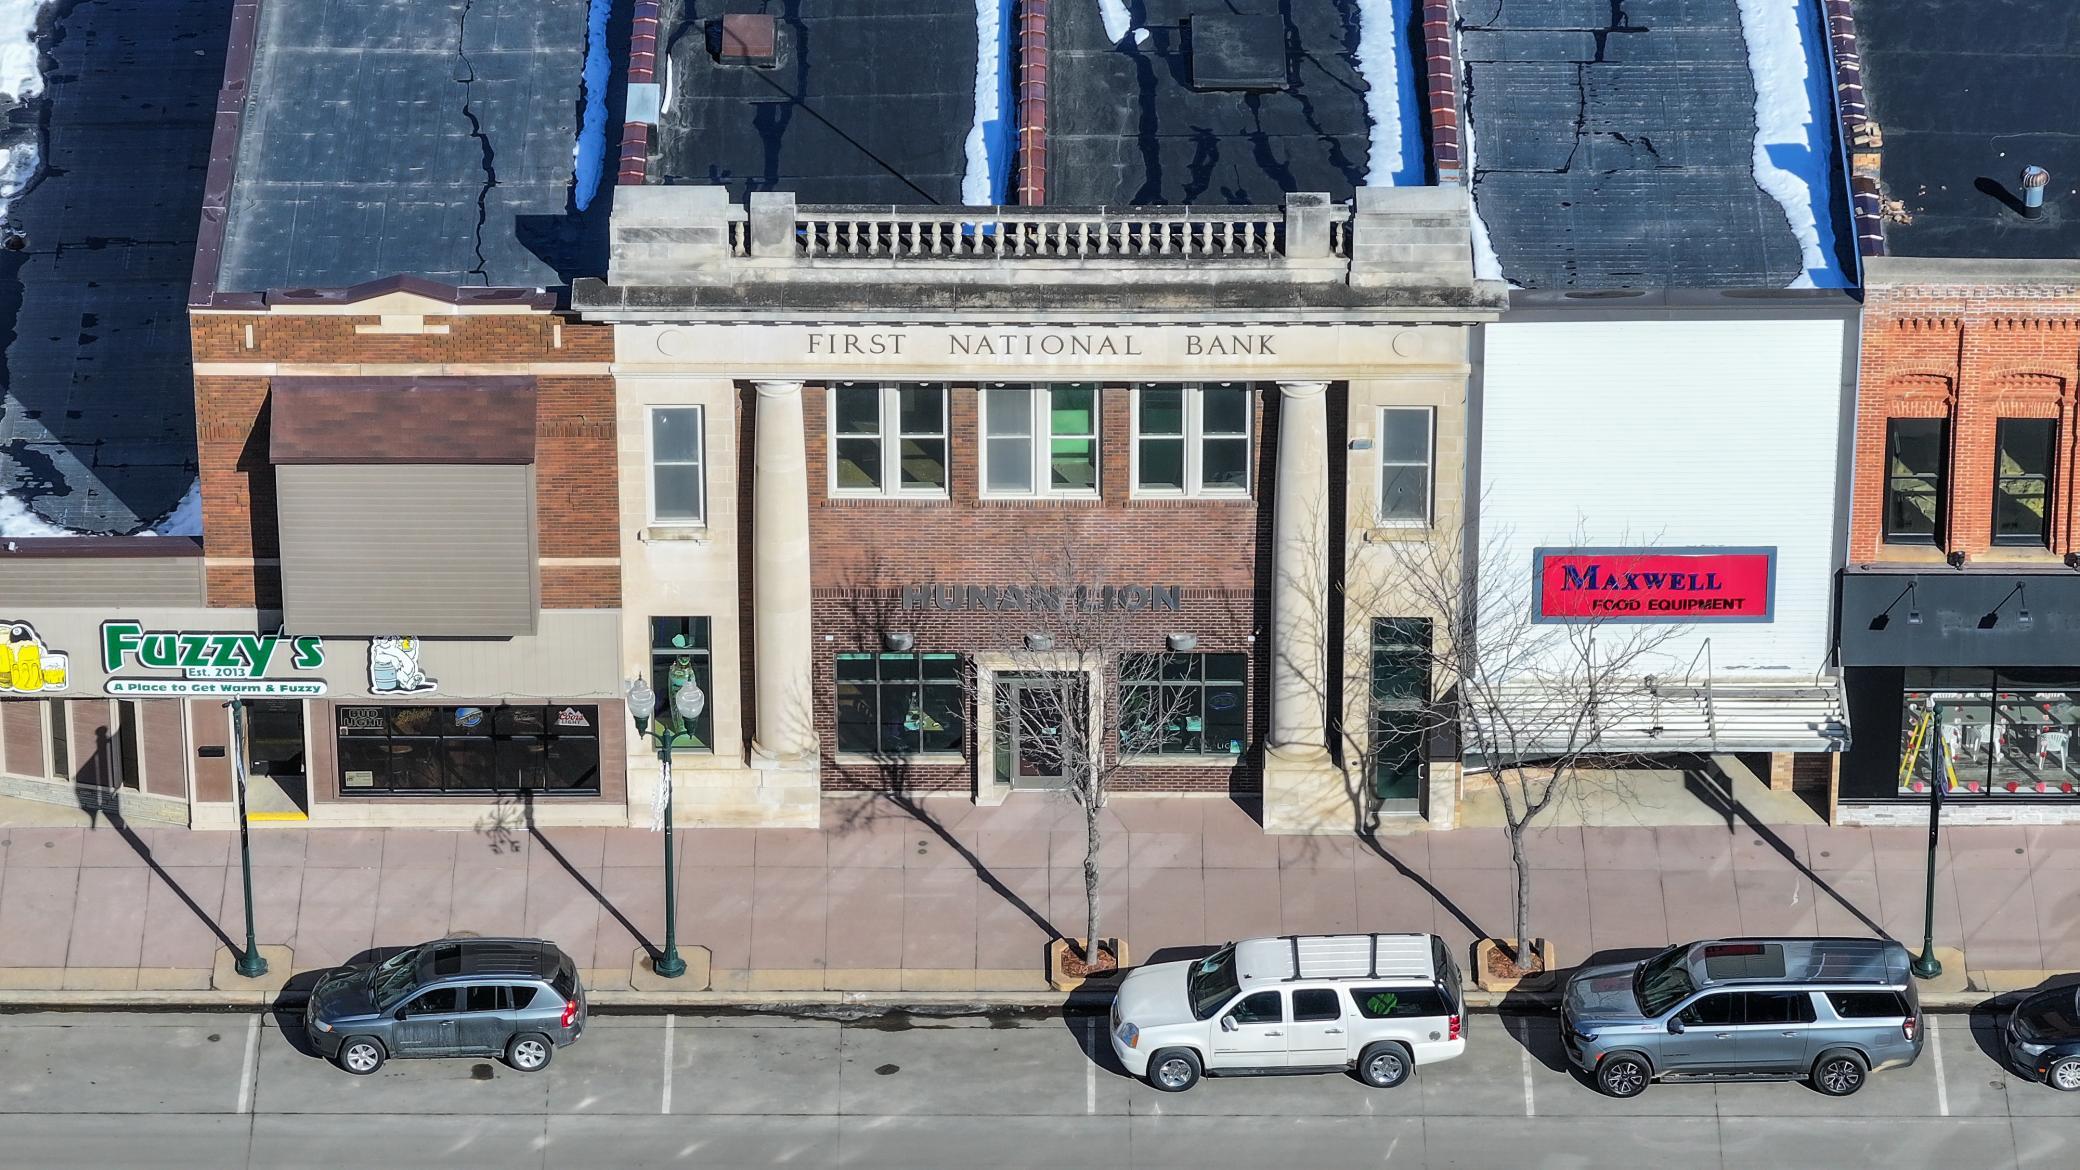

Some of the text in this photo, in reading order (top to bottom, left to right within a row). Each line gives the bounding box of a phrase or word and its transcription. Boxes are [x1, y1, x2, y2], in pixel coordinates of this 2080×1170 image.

[807, 333, 1277, 355] FIRST NATIONAL BANK
[1561, 564, 1723, 591] MAXWELL
[901, 584, 1181, 611] HUNAN LION
[1592, 597, 1746, 611] FOOD EQUIPMENT
[189, 667, 246, 678] Est. 2013
[113, 683, 321, 694] A Place to Get Warm & Fuzzy
[348, 709, 378, 719] BUD
[559, 711, 584, 721] Coors
[343, 717, 384, 727] LIGHT
